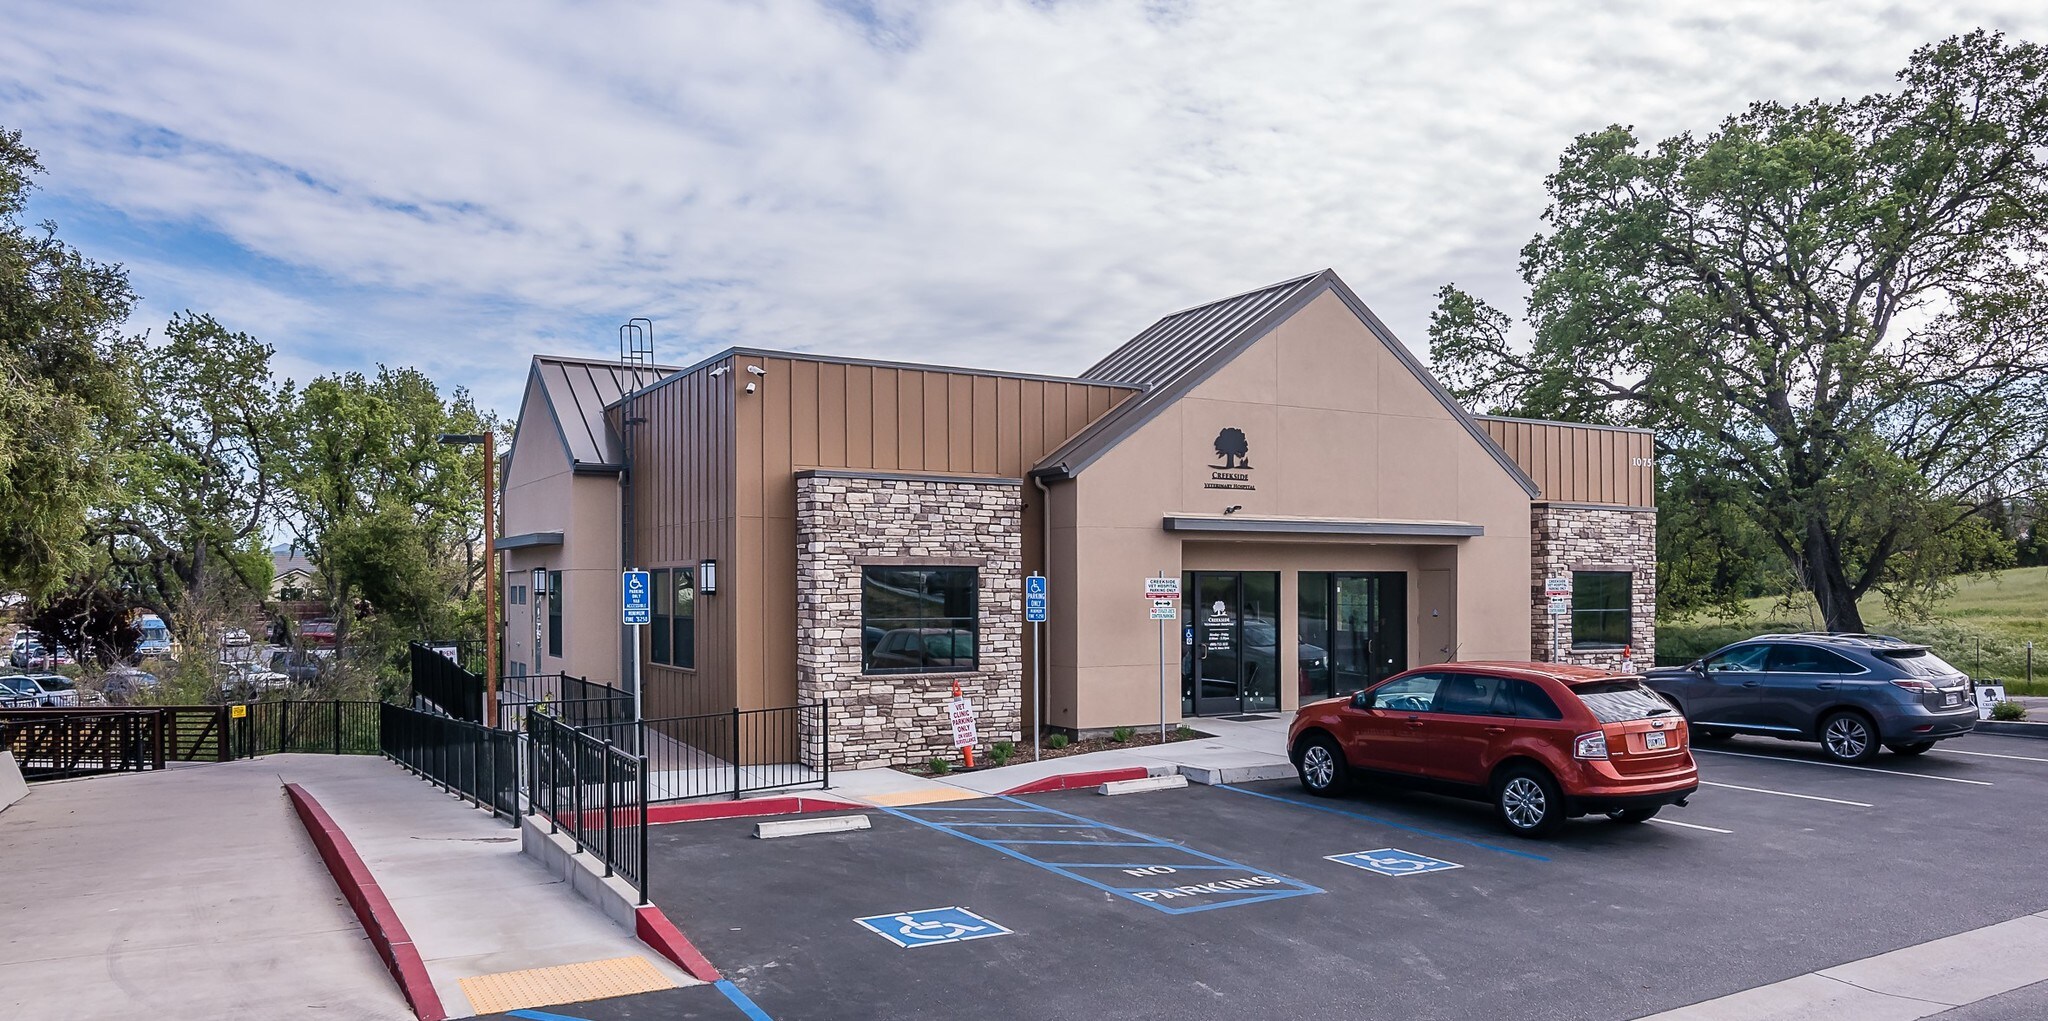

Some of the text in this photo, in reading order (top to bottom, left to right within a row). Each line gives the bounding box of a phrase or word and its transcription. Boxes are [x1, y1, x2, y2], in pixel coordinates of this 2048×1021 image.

[1632, 457, 1652, 467] 1075
[1212, 472, 1249, 481] CREEKSIDE
[955, 703, 965, 711] VET
[953, 710, 970, 718] CLINIC
[952, 717, 973, 726] PARKING
[1122, 865, 1177, 877] NO
[1132, 875, 1281, 902] PARKING
